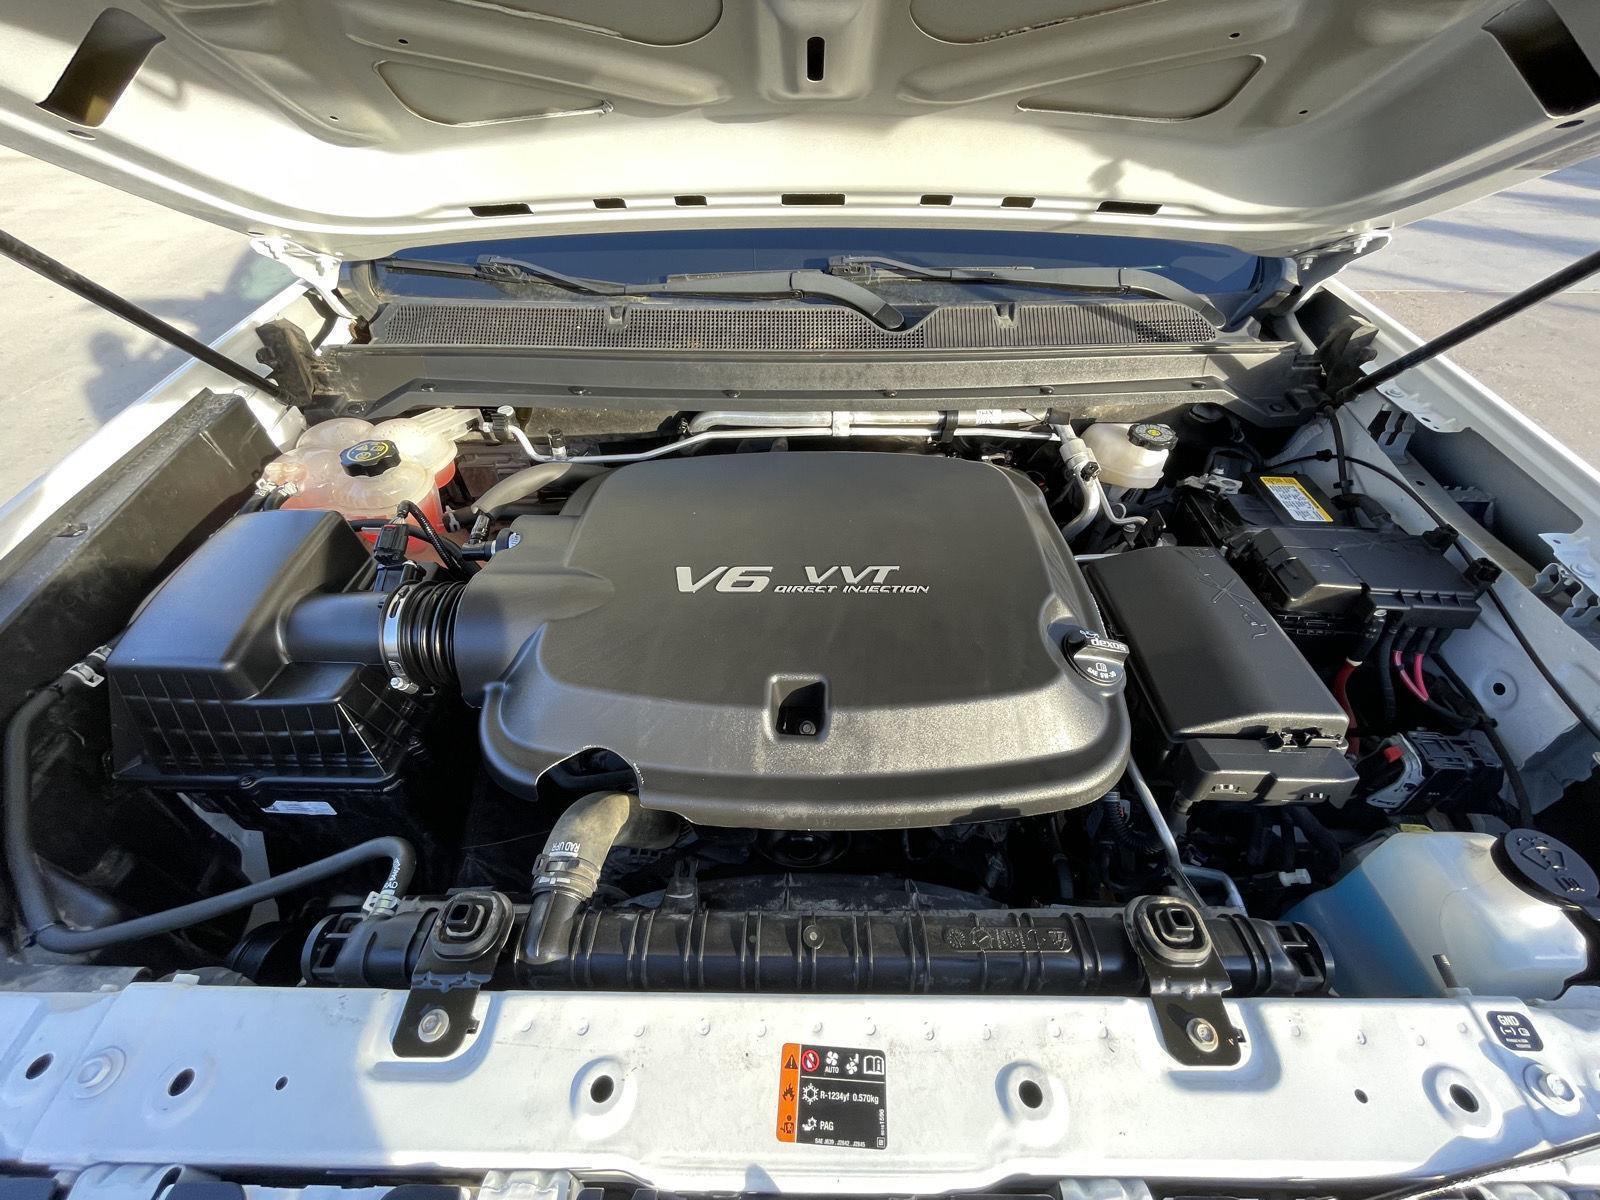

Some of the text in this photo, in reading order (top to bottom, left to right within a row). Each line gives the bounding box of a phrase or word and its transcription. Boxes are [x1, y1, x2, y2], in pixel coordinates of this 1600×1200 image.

[675, 565, 900, 593] V6 VVT
[773, 585, 930, 595] DIRECT INJECTION
[1090, 638, 1127, 652] dexos
[565, 841, 580, 853] RAD
[1497, 1015, 1519, 1026] GND
[824, 1066, 839, 1074] AUTO
[820, 1091, 879, 1104] R-1234yf 0.570kg
[820, 1121, 834, 1131] PAG
